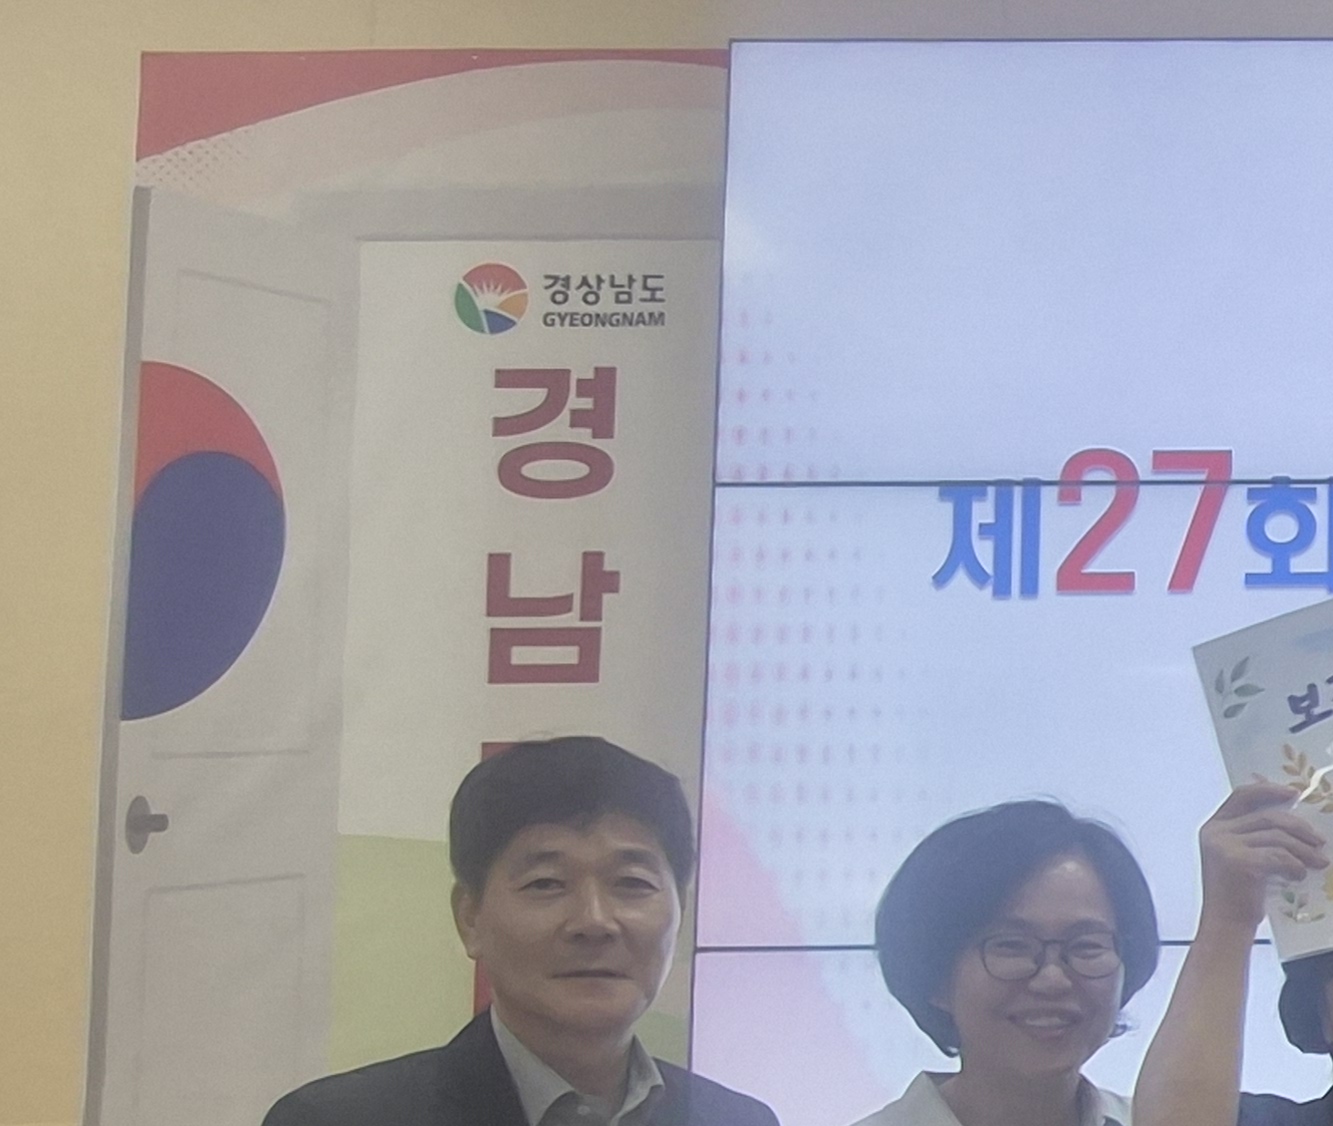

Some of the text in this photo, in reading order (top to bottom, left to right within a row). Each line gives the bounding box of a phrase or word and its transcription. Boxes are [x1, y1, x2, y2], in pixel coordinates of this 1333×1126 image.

[543, 274, 665, 305] 경상남도
[543, 312, 665, 327] GYEONGNAM
[481, 366, 621, 762] 경남
